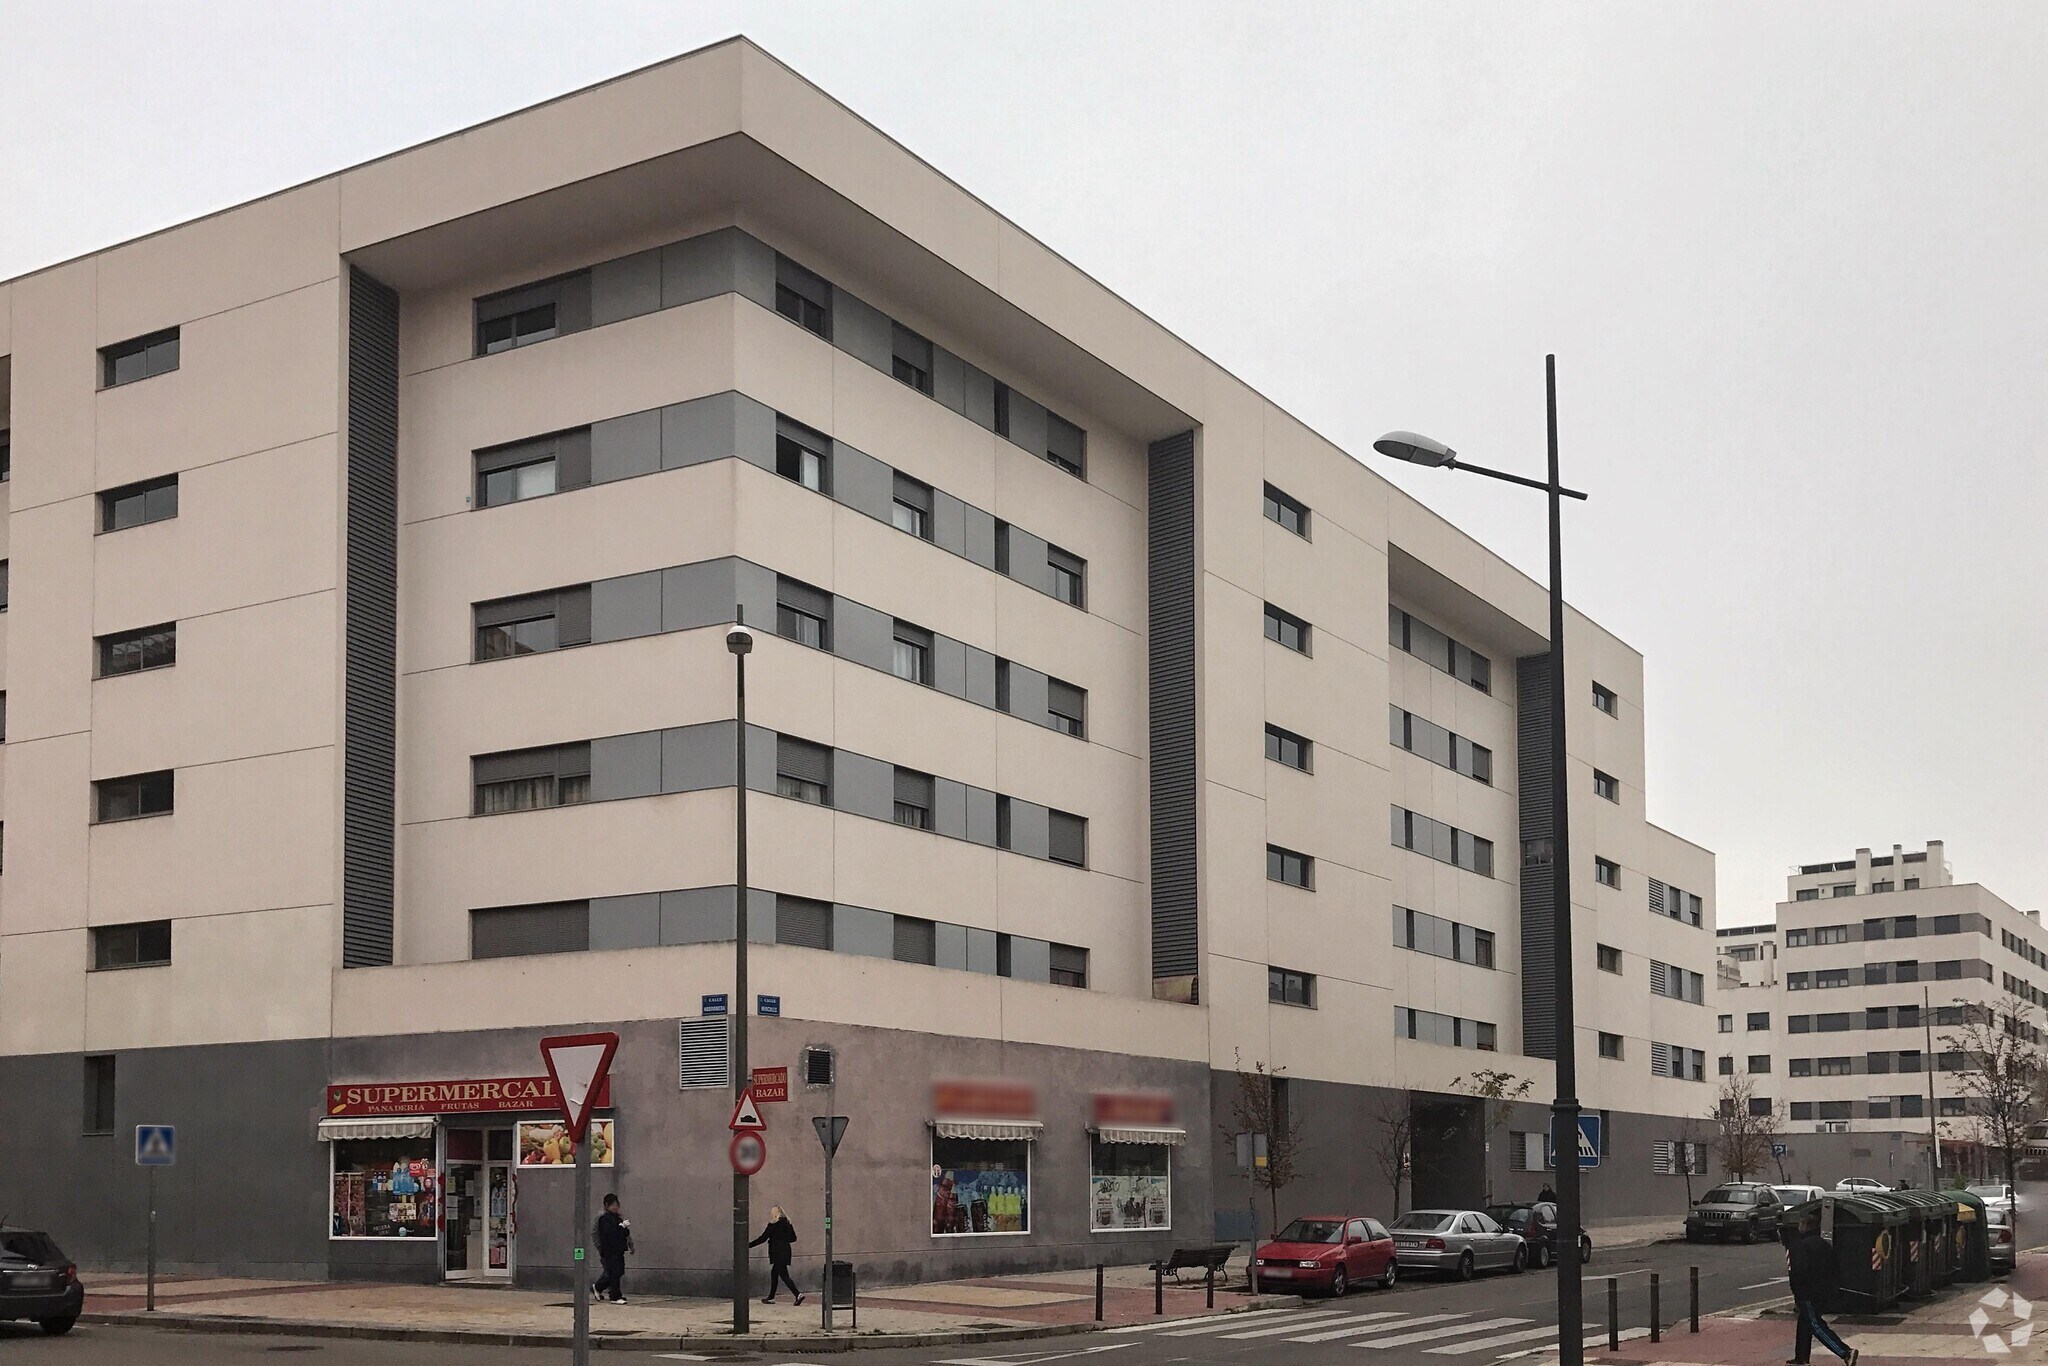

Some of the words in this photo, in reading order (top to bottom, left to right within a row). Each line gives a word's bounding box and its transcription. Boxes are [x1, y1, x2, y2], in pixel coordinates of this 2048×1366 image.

[756, 1088, 784, 1098] BAZAR
[368, 1104, 425, 1113] PANADERIA
[440, 1101, 480, 1110] FRUTAS
[498, 1100, 534, 1108] BAZAR
